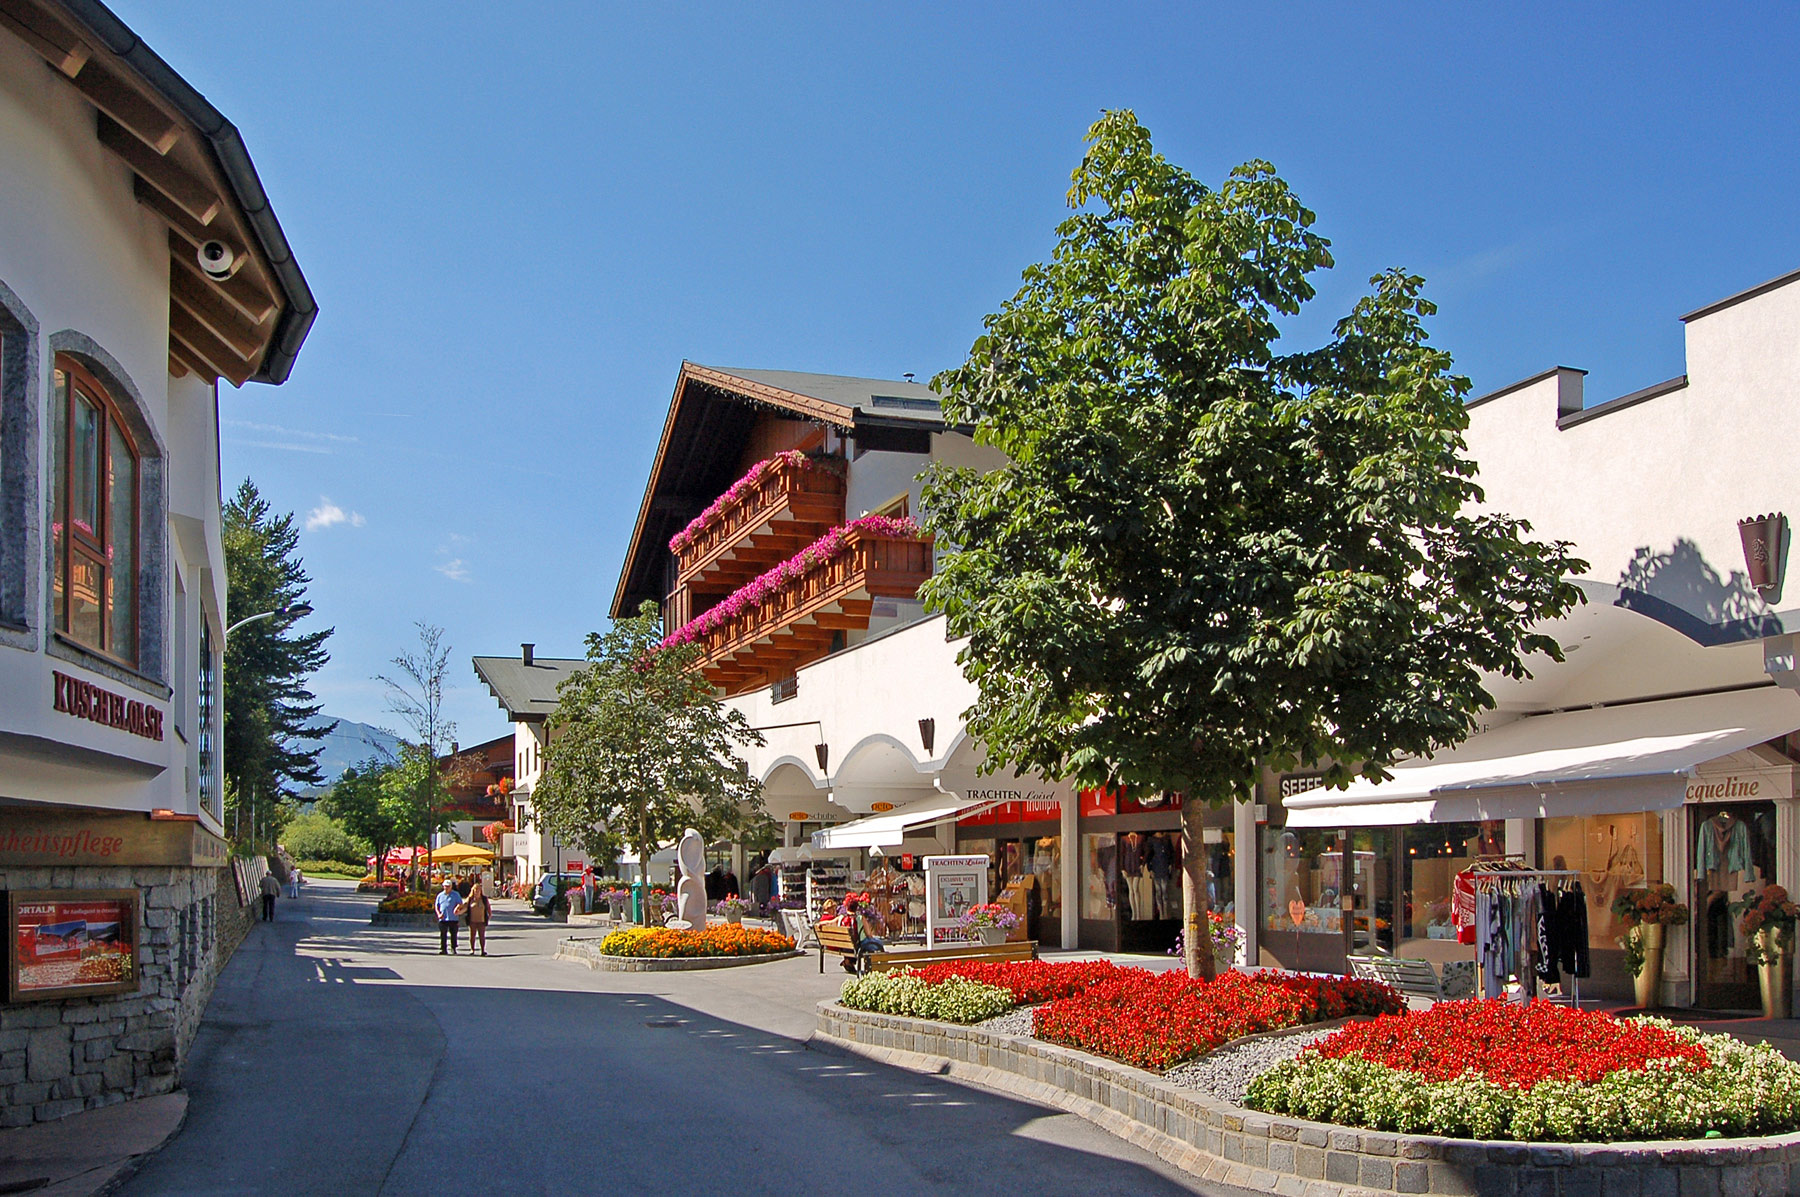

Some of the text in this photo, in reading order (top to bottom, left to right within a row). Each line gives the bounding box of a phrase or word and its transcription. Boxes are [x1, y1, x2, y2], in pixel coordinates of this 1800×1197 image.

[52, 670, 164, 741] KUSCHELOASE
[967, 789, 1021, 799] TRACHTEN
[1686, 776, 1759, 803] cqueline
